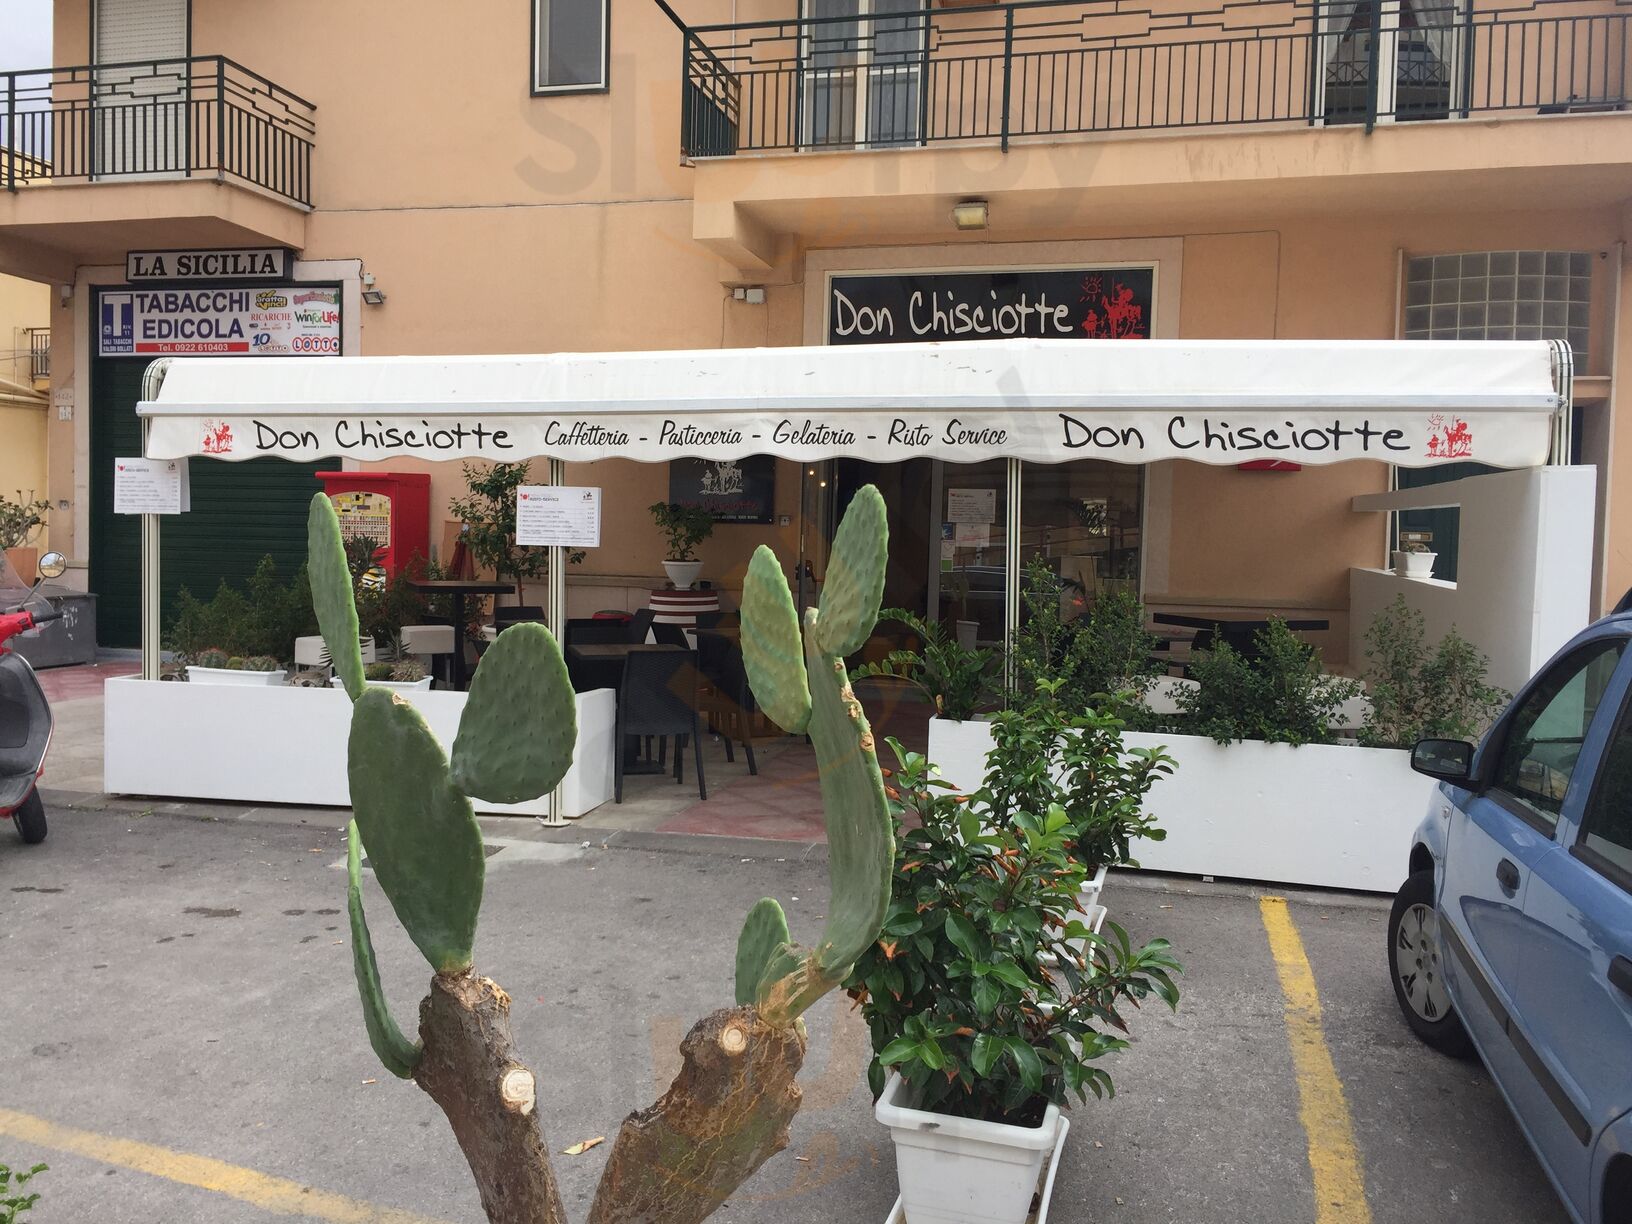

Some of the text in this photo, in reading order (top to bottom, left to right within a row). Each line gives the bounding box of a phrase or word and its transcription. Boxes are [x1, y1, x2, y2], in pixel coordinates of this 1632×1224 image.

[133, 253, 278, 277] LA SICILIA
[135, 291, 250, 313] TABACCHI
[834, 289, 1074, 336] Don Chisciotte
[104, 295, 131, 336] T
[251, 313, 292, 321] RICARICHE
[143, 318, 245, 339] EDICOLA
[252, 333, 271, 346] 10
[158, 344, 229, 352] Tel. 0922 610403
[252, 420, 319, 450] Don
[334, 420, 514, 450] Chisciotte
[543, 421, 630, 447] Caffetteria
[658, 419, 742, 446] Pasticceria
[772, 419, 856, 446] Gelateria
[887, 418, 933, 447] Risto
[941, 418, 1008, 446] Service
[1058, 412, 1145, 450] Don
[1167, 415, 1412, 451] Chisciotte
